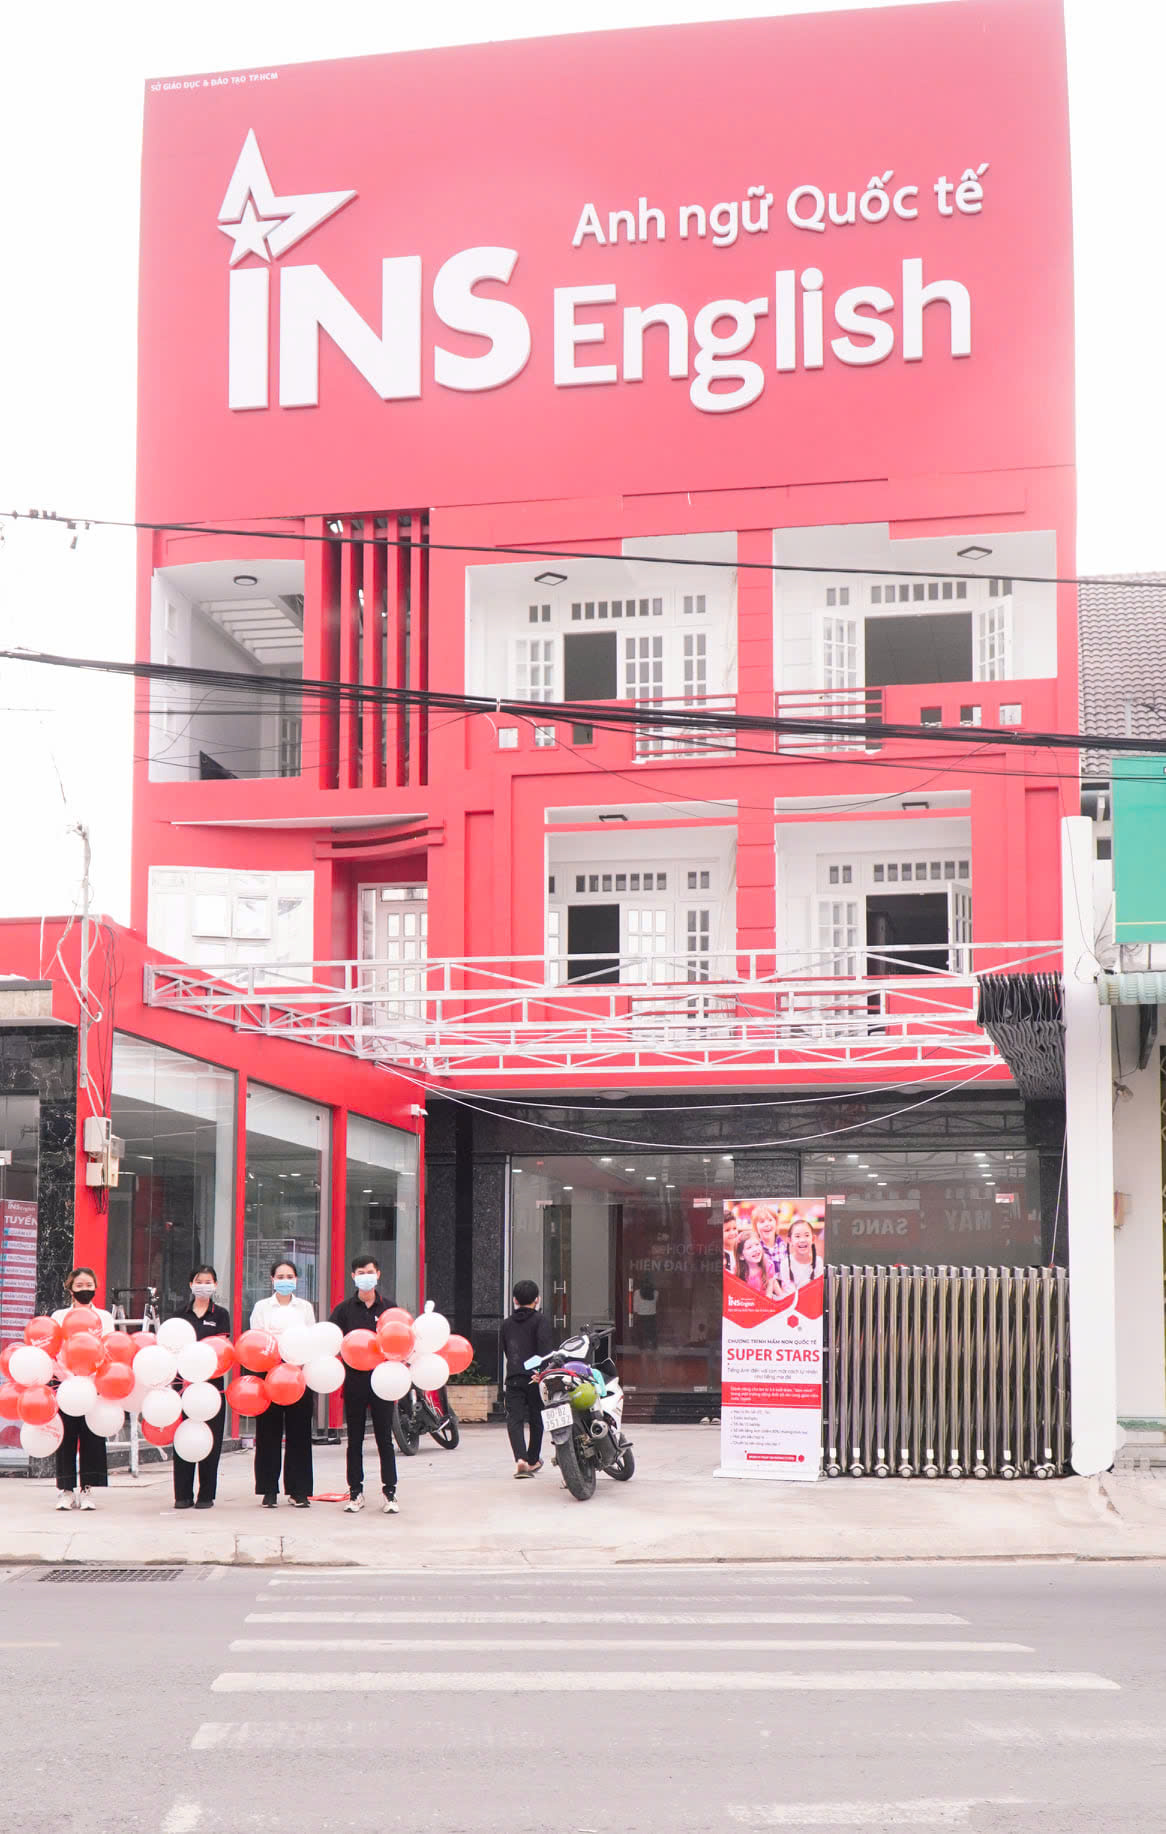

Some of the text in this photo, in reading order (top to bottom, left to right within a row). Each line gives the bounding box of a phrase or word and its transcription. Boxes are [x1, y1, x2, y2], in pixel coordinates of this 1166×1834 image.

[163, 80, 182, 90] GIÁO
[203, 79, 209, 87] &
[231, 75, 247, 85] TẠO
[249, 72, 278, 81] TP.HCM
[572, 162, 989, 247] Anh ngữ Quốc tế
[553, 258, 972, 414] English
[727, 1348, 820, 1362] SUPER STARS
